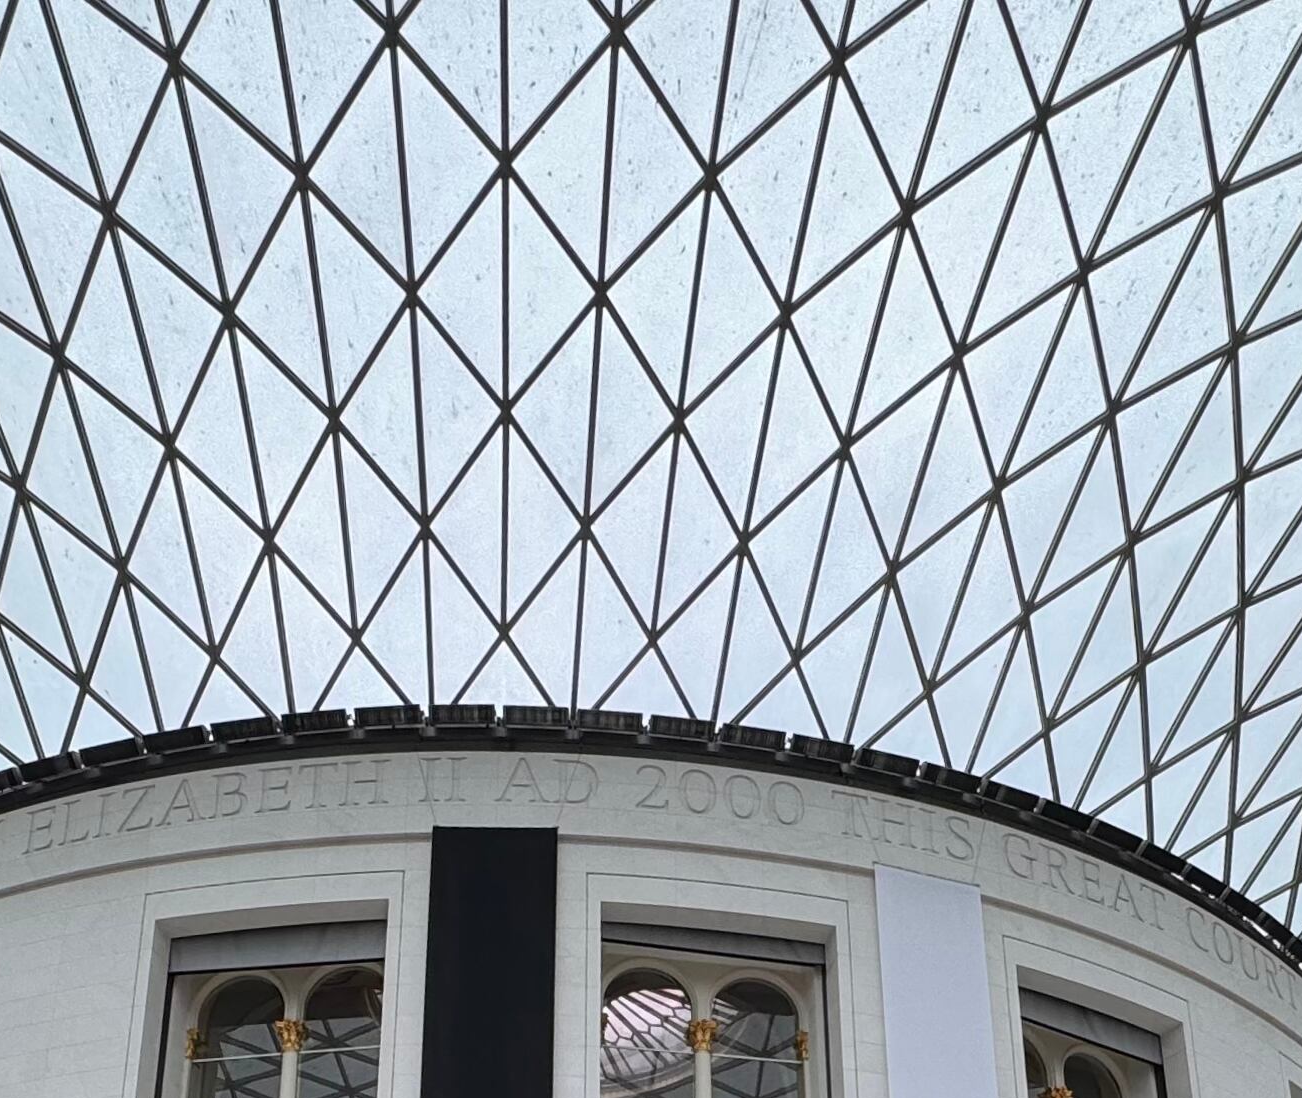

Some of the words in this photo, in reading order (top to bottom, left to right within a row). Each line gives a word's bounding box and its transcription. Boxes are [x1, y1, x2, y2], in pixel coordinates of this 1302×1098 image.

[22, 758, 393, 855] ELIZABETH
[418, 756, 468, 803] II
[498, 756, 597, 805] AD
[634, 763, 805, 826] 2000
[830, 789, 976, 862] THIS
[1002, 832, 1167, 932] GREAT
[1185, 906, 1301, 1010] COURT
